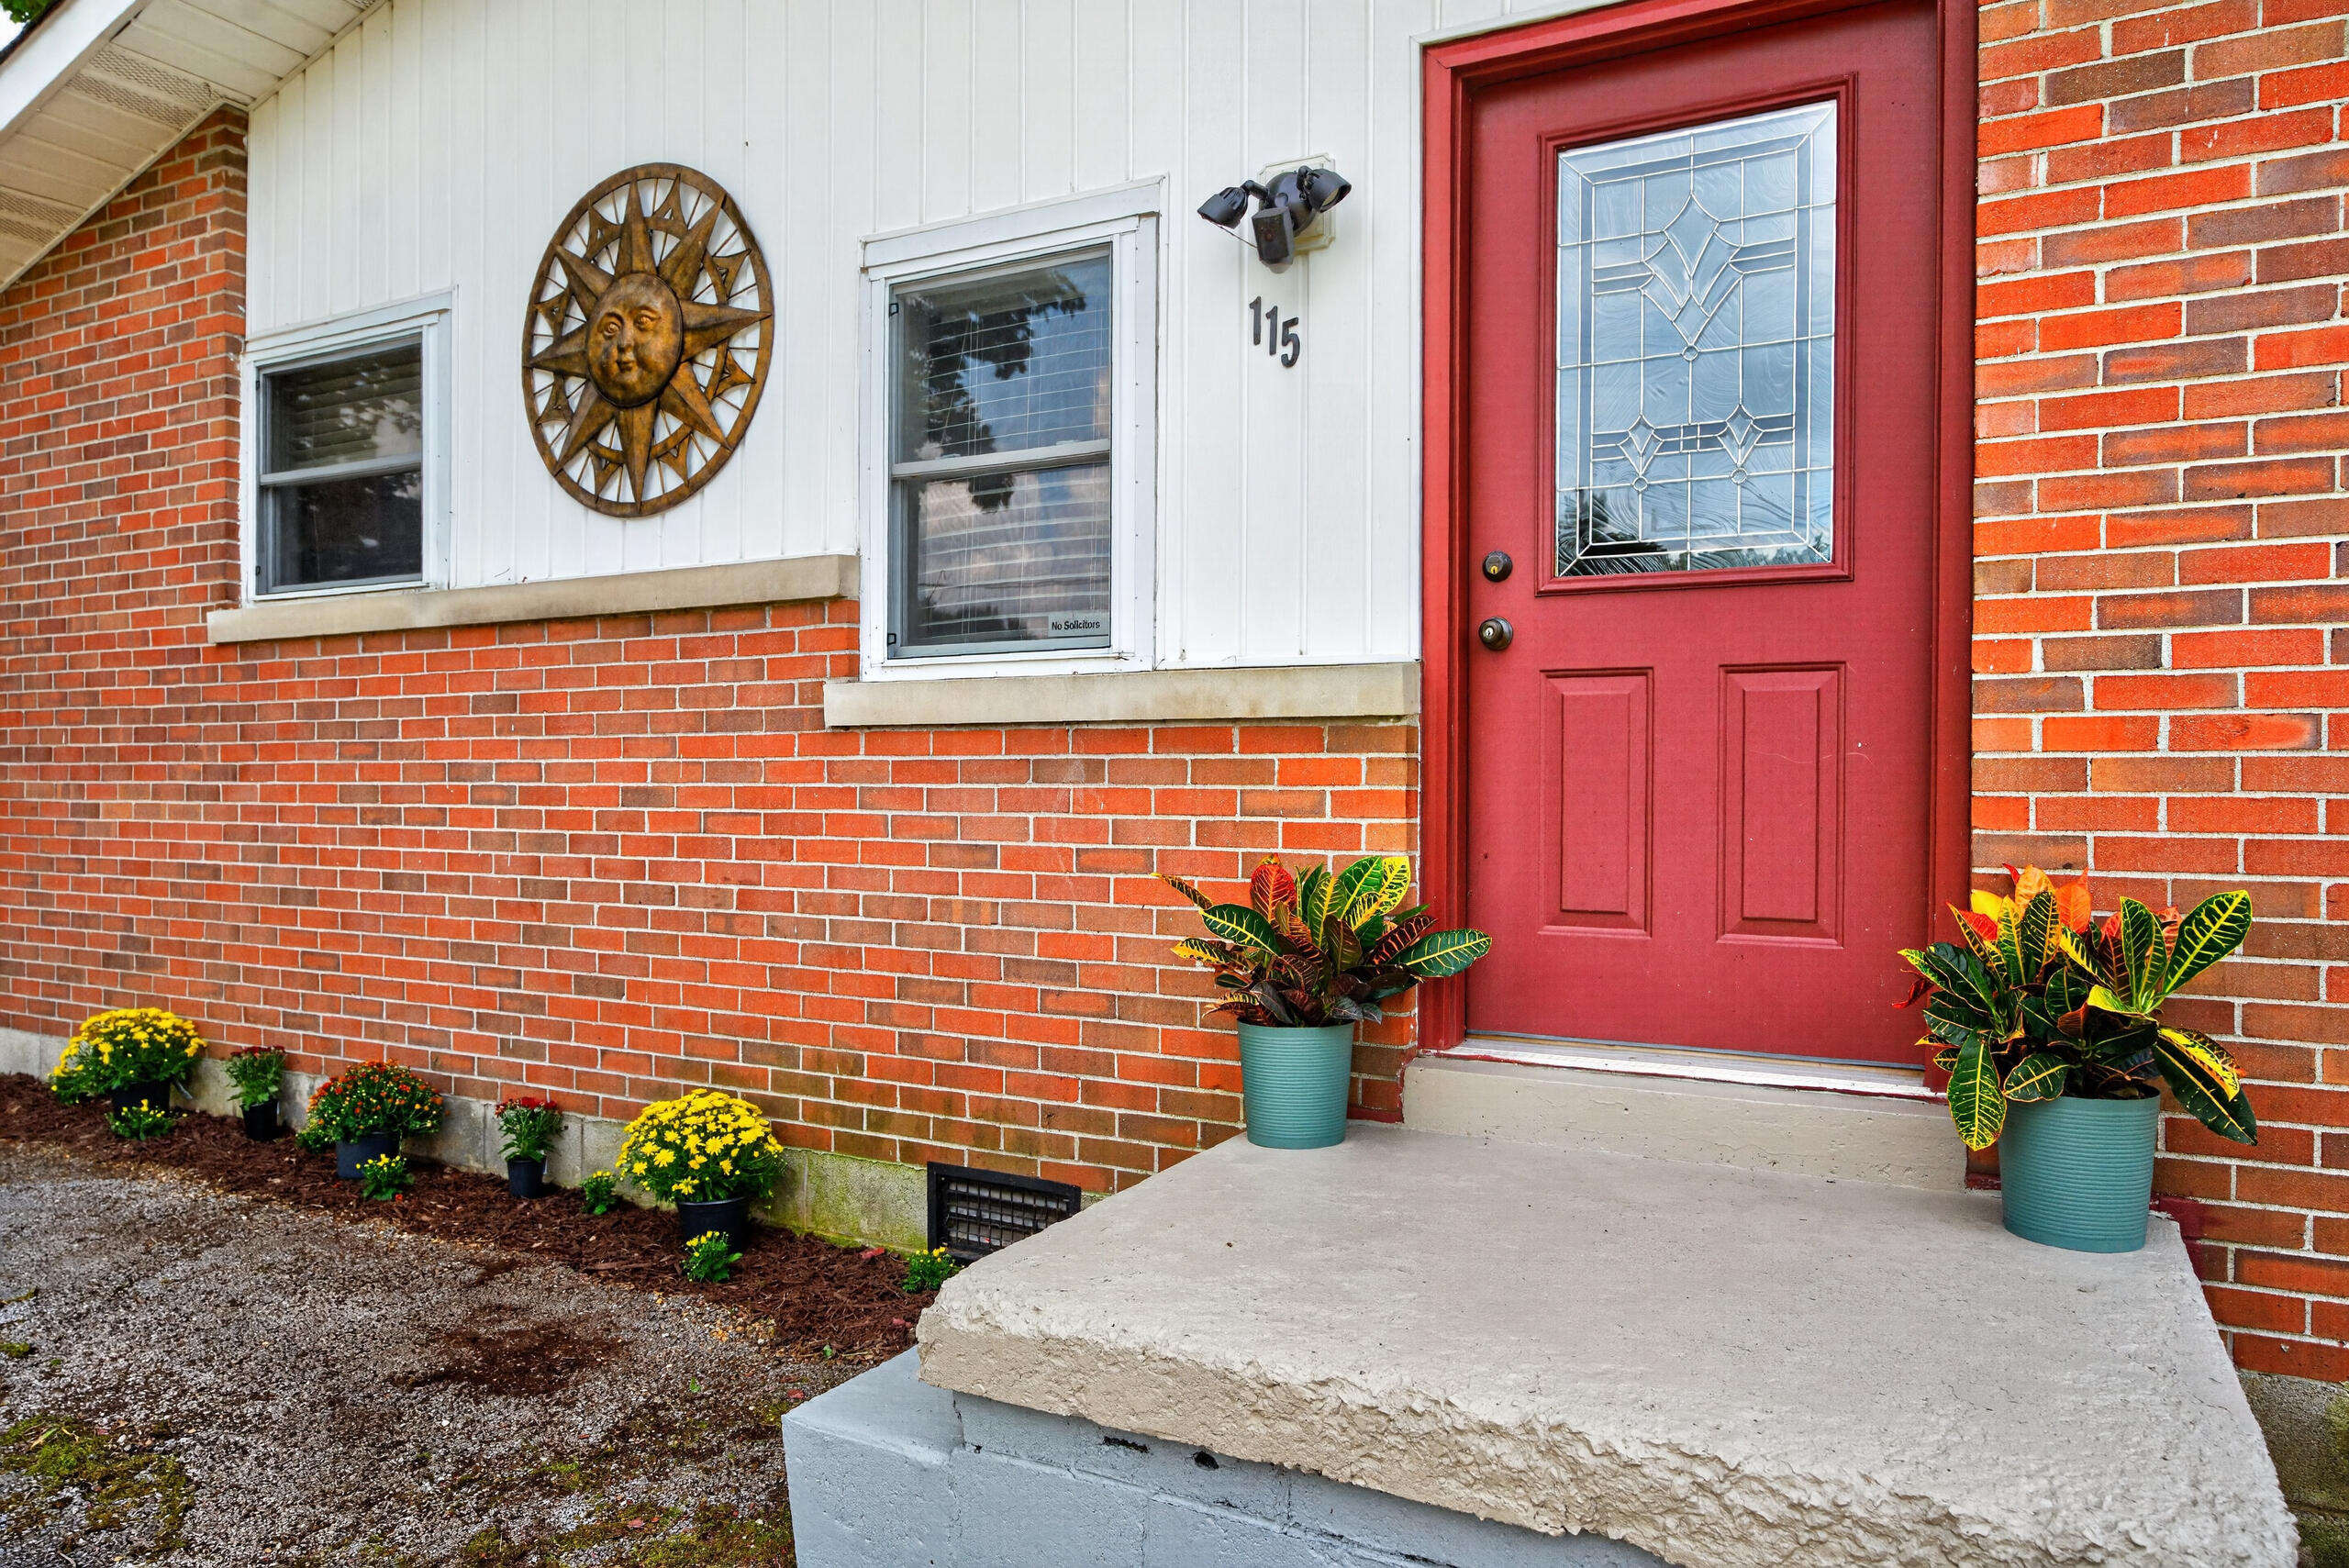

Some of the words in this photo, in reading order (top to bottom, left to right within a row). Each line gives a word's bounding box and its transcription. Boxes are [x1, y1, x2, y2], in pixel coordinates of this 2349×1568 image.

[1249, 296, 1300, 368] 115
[1052, 621, 1063, 630] No
[1064, 619, 1100, 630] Solicitors
